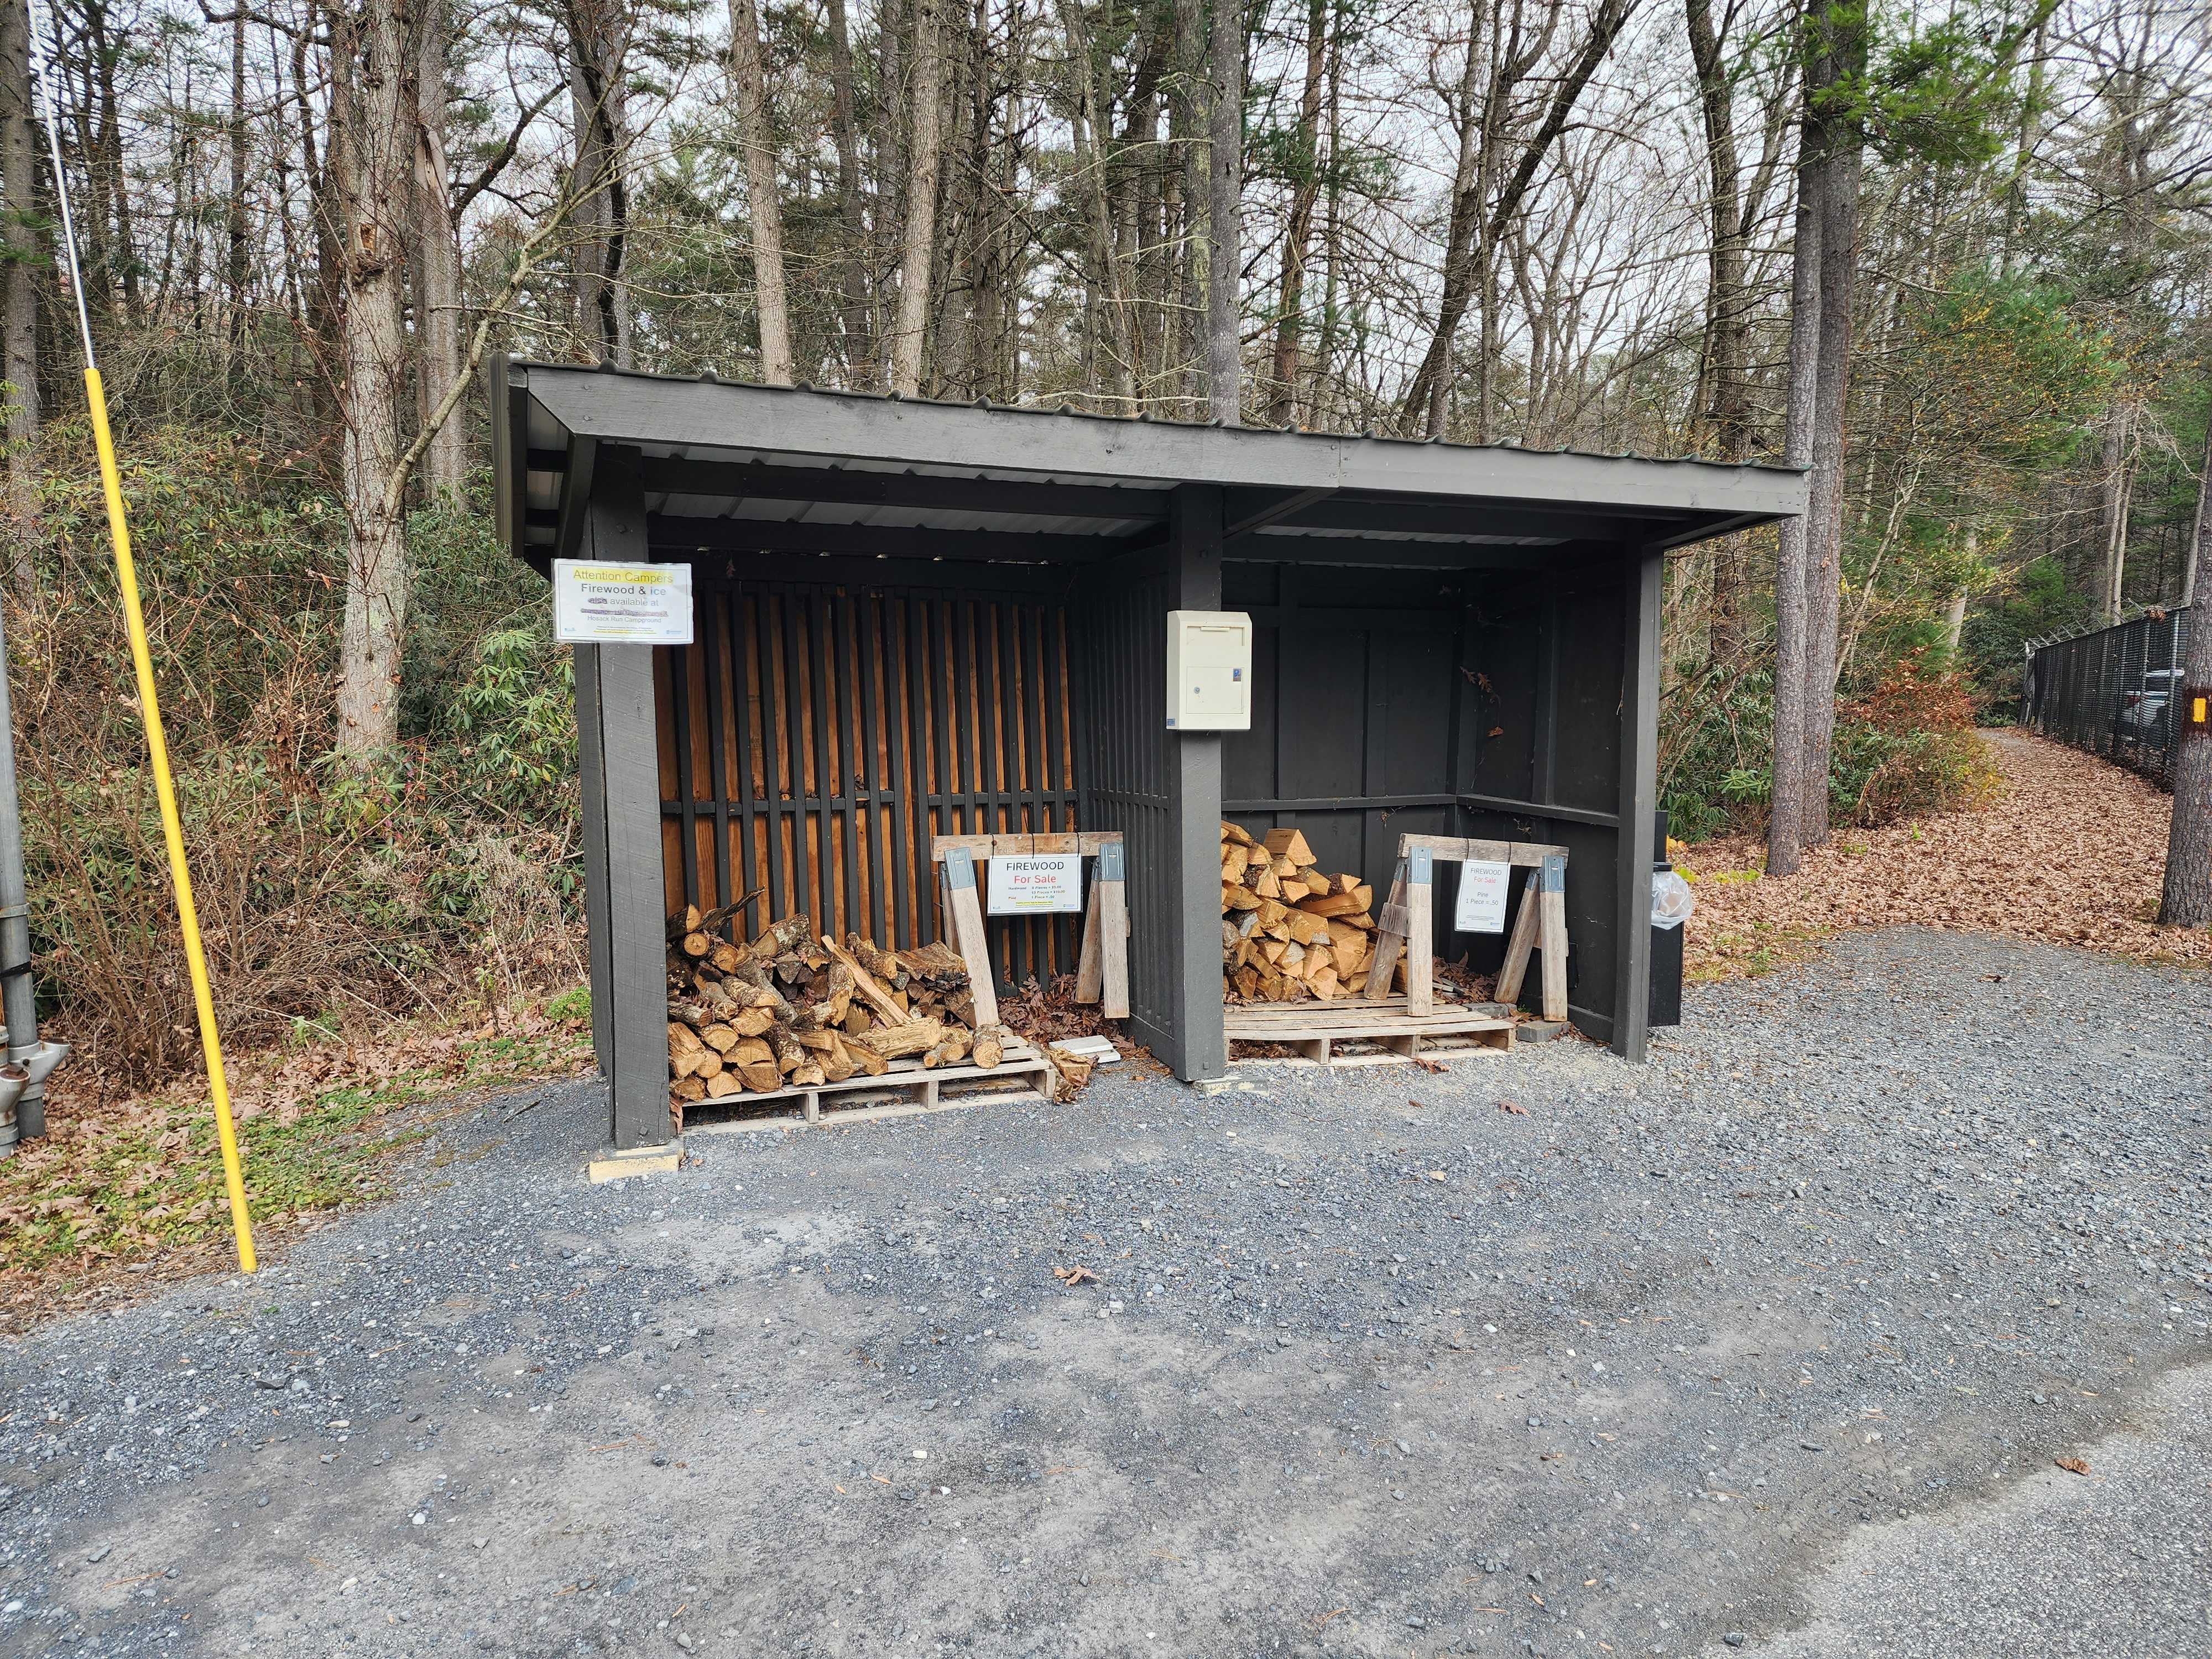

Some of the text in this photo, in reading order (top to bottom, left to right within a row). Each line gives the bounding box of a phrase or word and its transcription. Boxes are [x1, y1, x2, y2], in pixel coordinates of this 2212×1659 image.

[573, 570, 673, 584] Attention Campers
[581, 584, 634, 594] Firewood
[638, 586, 646, 594] &
[610, 598, 648, 606] available
[1006, 862, 1065, 871] FIREWOOD
[1014, 874, 1056, 884] For Sale
